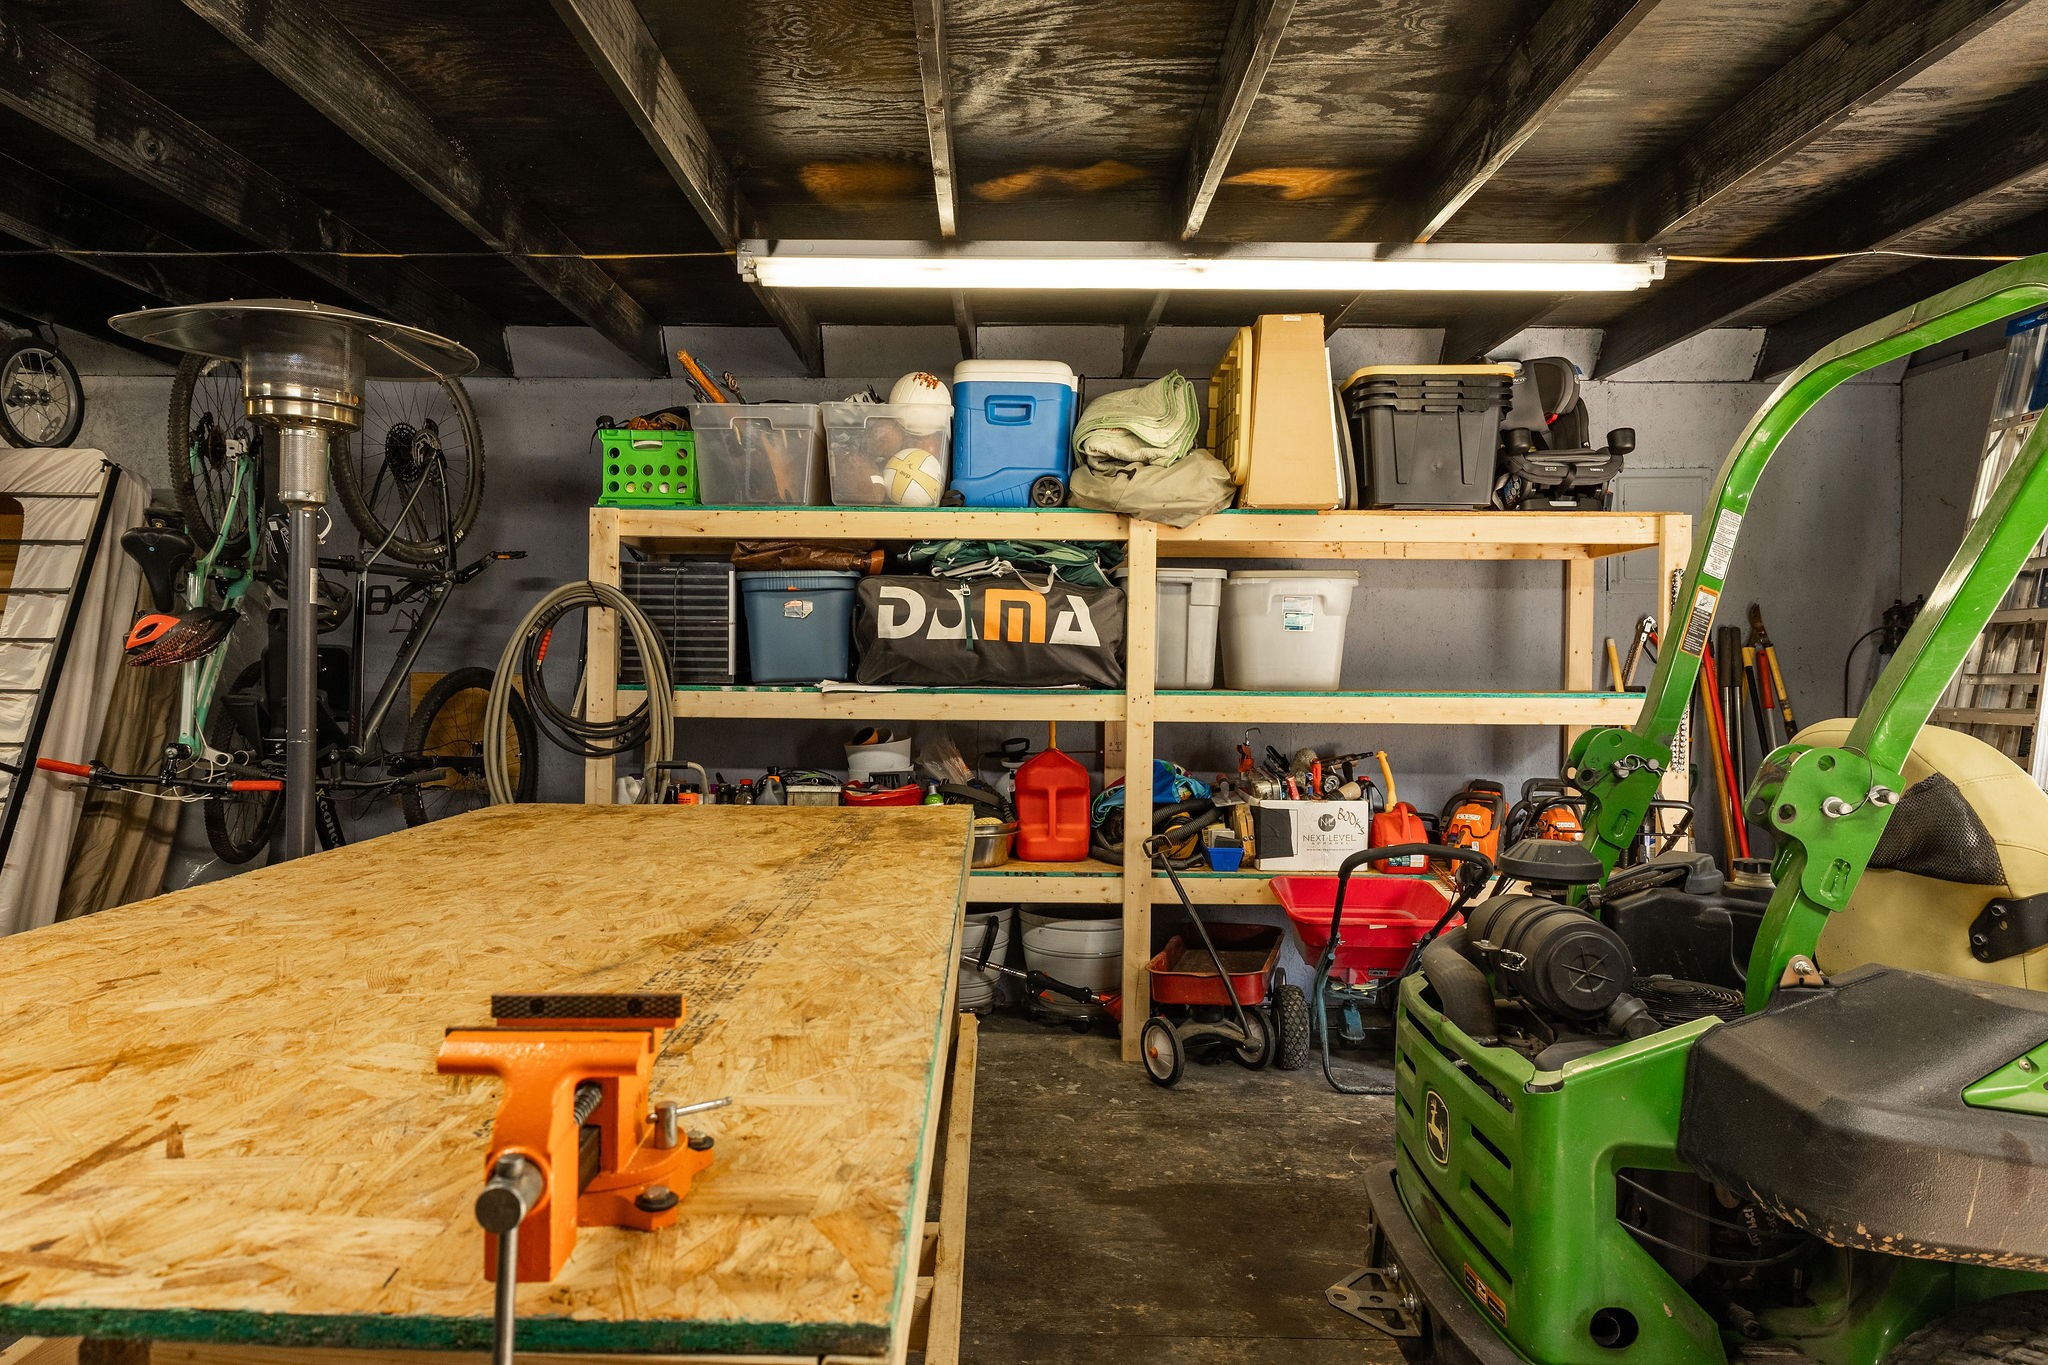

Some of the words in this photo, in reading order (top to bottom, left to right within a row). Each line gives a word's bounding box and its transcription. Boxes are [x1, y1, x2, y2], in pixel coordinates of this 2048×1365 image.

[1337, 807, 1365, 835] BOOKS
[1302, 834, 1325, 842] NEXT
[1328, 834, 1357, 842] LEVEL
